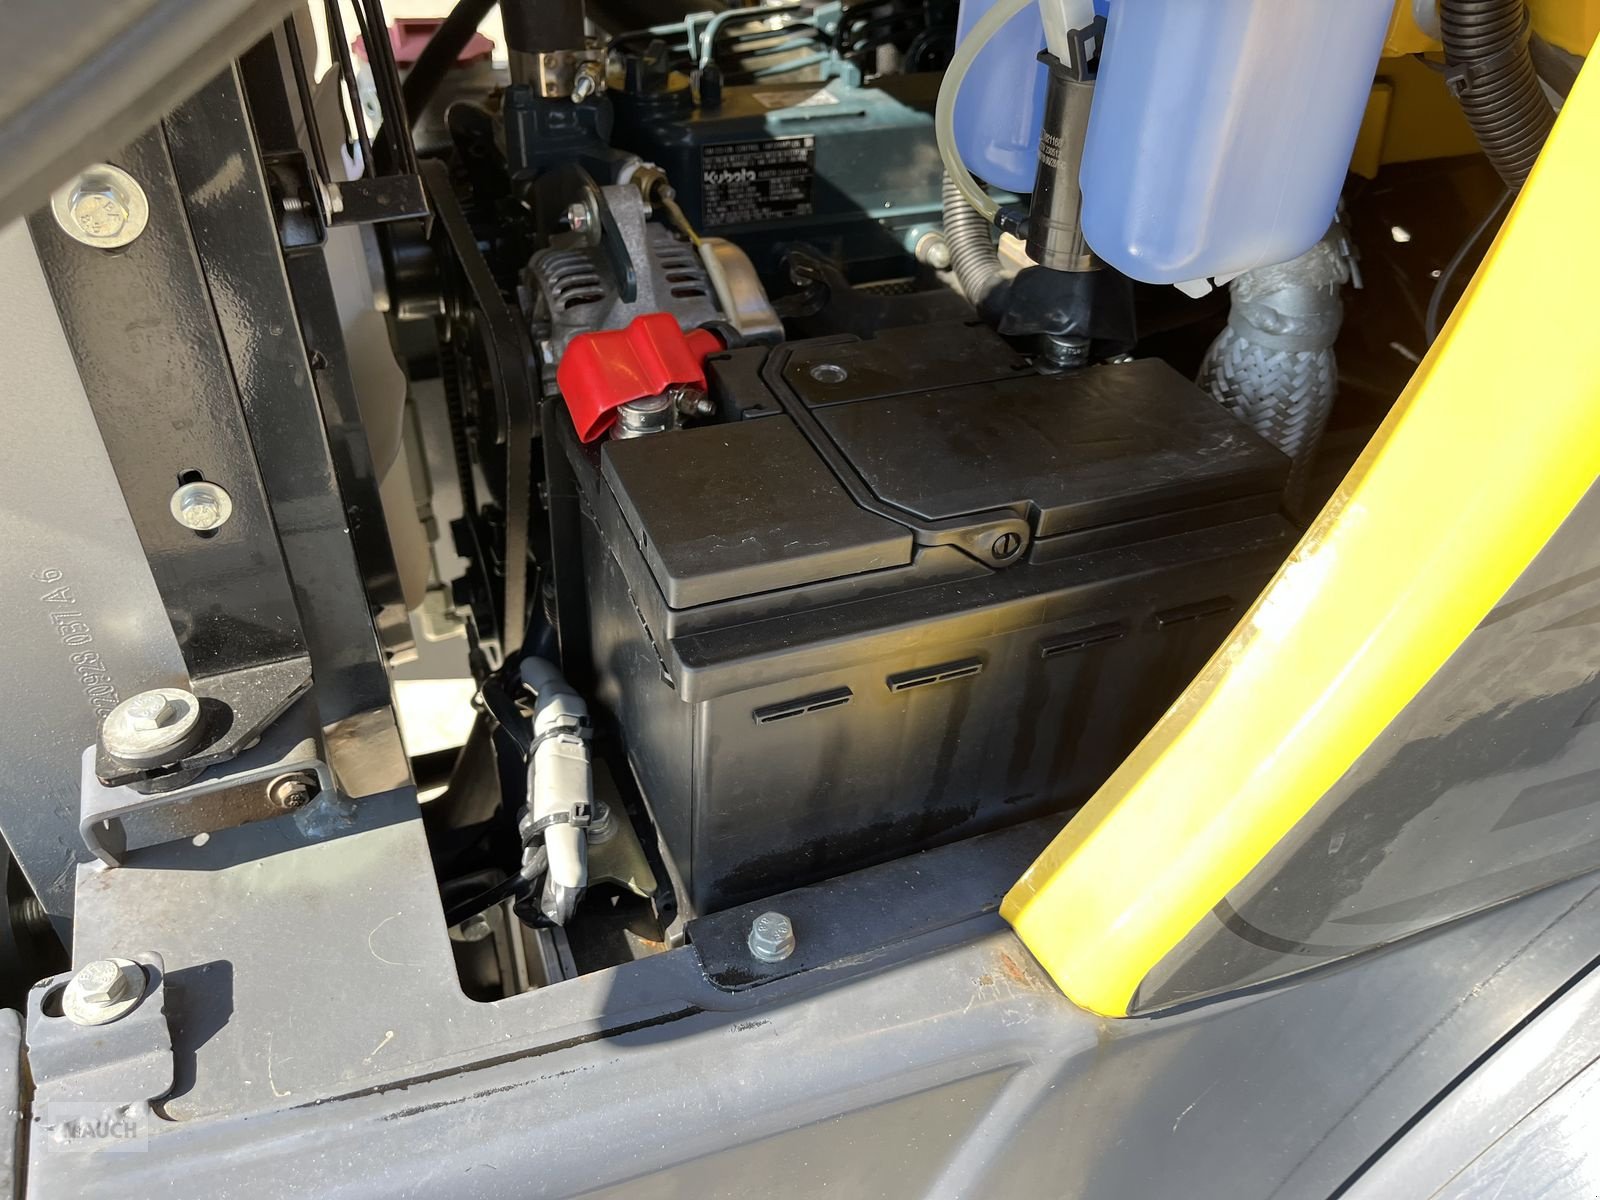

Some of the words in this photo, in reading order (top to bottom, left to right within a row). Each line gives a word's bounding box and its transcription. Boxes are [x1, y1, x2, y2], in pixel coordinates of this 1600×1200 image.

[704, 168, 756, 184] Kubota
[31, 568, 63, 584] 6
[40, 586, 76, 604] A
[50, 611, 93, 647] 037
